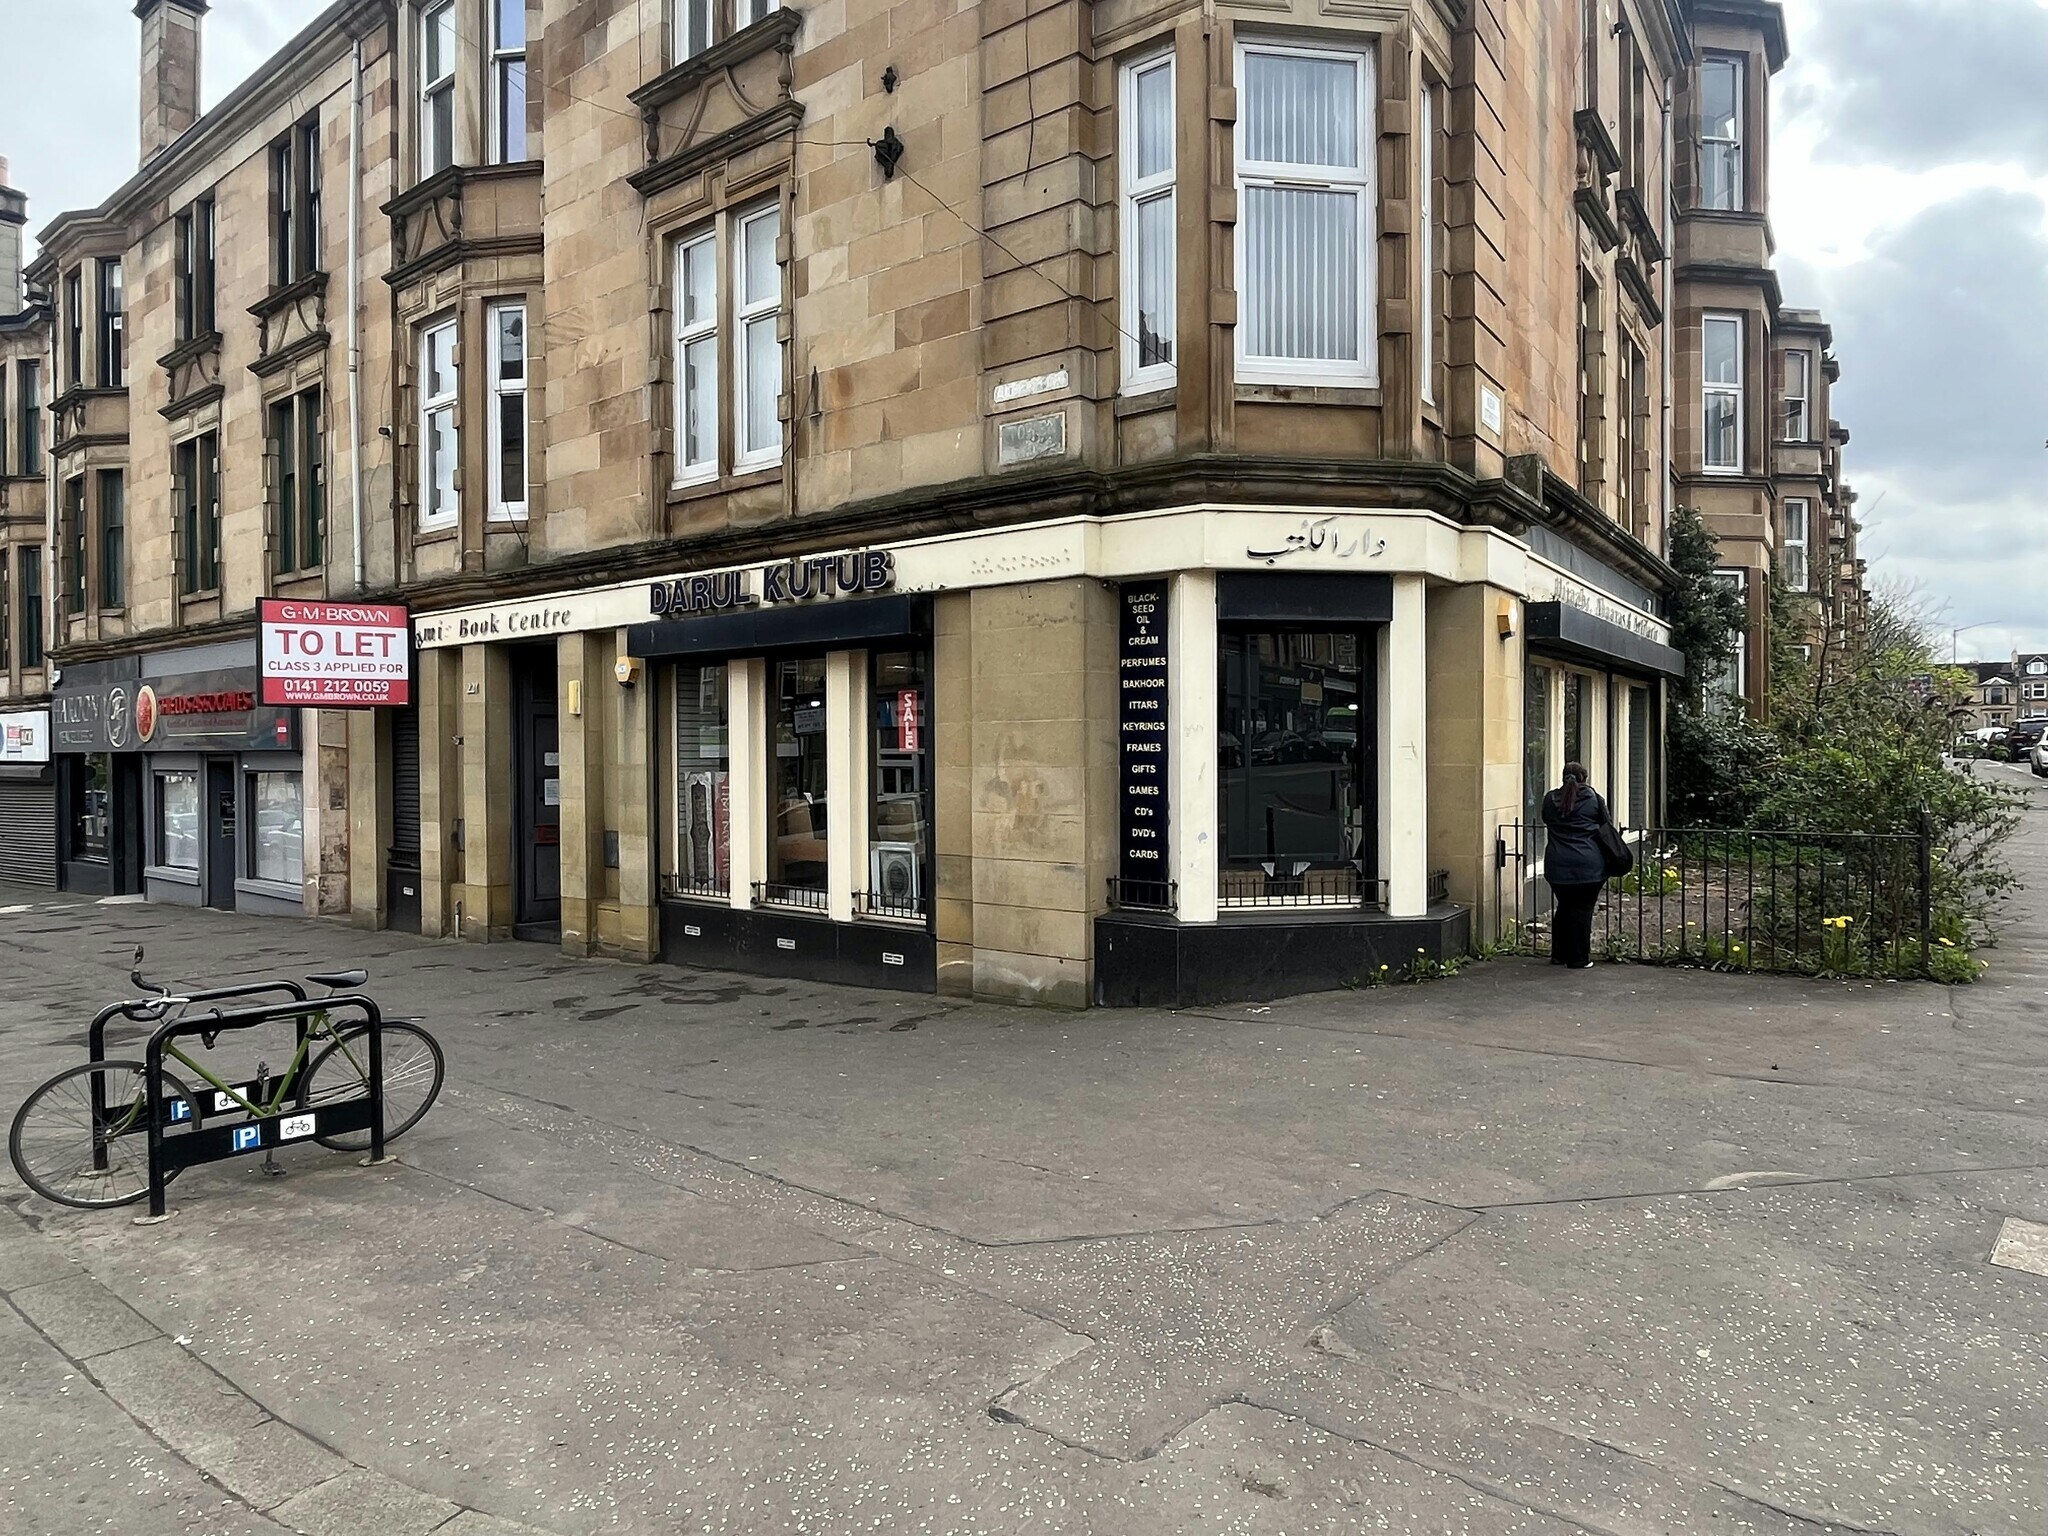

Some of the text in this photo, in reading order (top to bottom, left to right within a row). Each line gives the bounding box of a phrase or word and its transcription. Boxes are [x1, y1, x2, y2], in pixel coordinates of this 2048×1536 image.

[649, 549, 889, 615] DARUL KUTUB
[1132, 604, 1154, 613] SEED
[459, 612, 500, 638] Book
[508, 608, 571, 632] Centre
[1136, 615, 1150, 624] OIL
[1140, 626, 1146, 634] &
[275, 629, 396, 657] TO LET
[1128, 636, 1158, 645] CREAM
[268, 660, 403, 673] CLASS 3 APPLIED FOR
[1121, 657, 1166, 667] PERFUMES
[284, 680, 389, 692] 0141 212 0059
[1123, 679, 1165, 688] BAKHOOR
[286, 692, 389, 701] WWW.GMBROWN.CO.UK
[1129, 700, 1158, 709] ITTARS
[904, 693, 914, 749] SALE
[1123, 722, 1165, 731] KEYRINGS
[1126, 743, 1161, 752] FRAMES
[1131, 765, 1156, 773] GIFTS
[1129, 786, 1159, 795] GAMES
[1134, 807, 1153, 816] CD's
[1132, 828, 1156, 837] DVD's
[1129, 849, 1158, 859] CARDS
[240, 1128, 256, 1148] P
